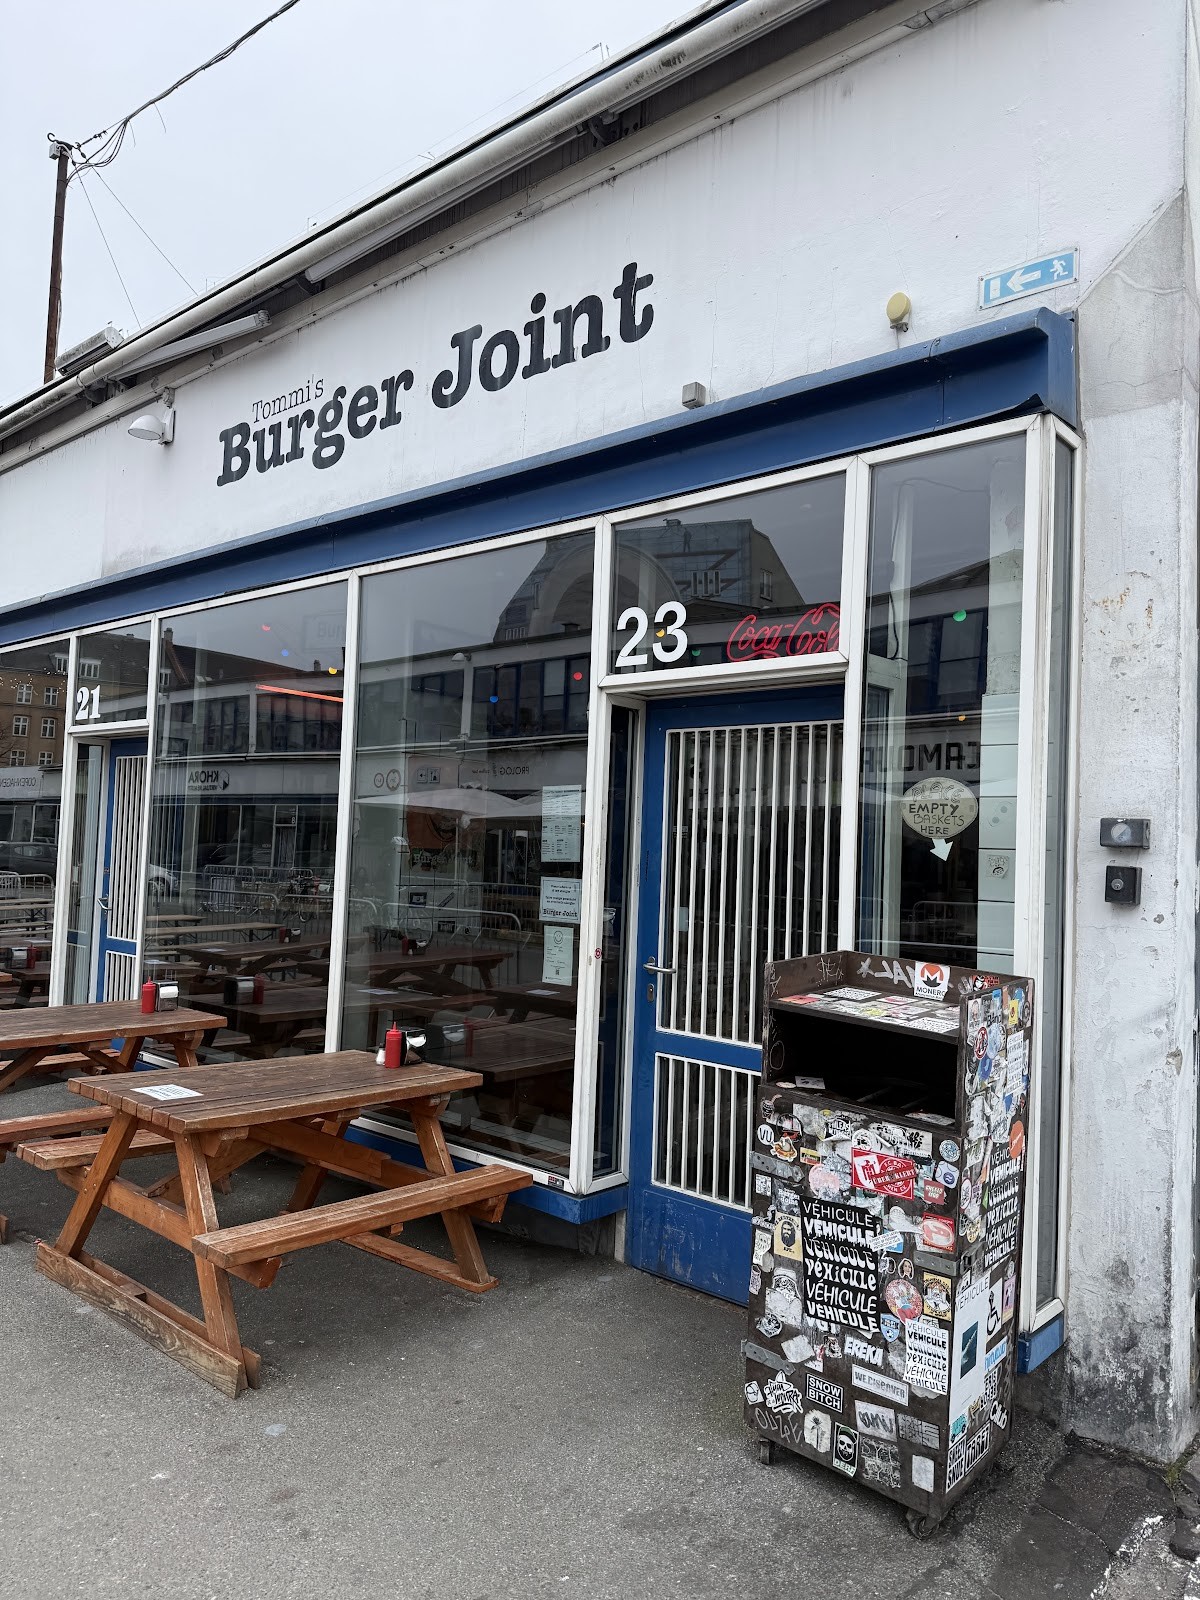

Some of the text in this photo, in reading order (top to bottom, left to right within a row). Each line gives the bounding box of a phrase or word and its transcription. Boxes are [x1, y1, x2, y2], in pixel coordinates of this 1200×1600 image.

[217, 262, 655, 487] Burger Joint
[252, 374, 325, 423] Tommi's
[615, 601, 689, 667] 23
[727, 603, 840, 662] Coca-Col
[76, 685, 101, 720] 21
[911, 782, 965, 804] PLACE
[908, 803, 960, 815] EMPTY
[913, 814, 965, 826] BASKETS
[920, 825, 949, 835] HERE
[808, 1377, 842, 1398] SNOW
[808, 1389, 842, 1410] BITCH
